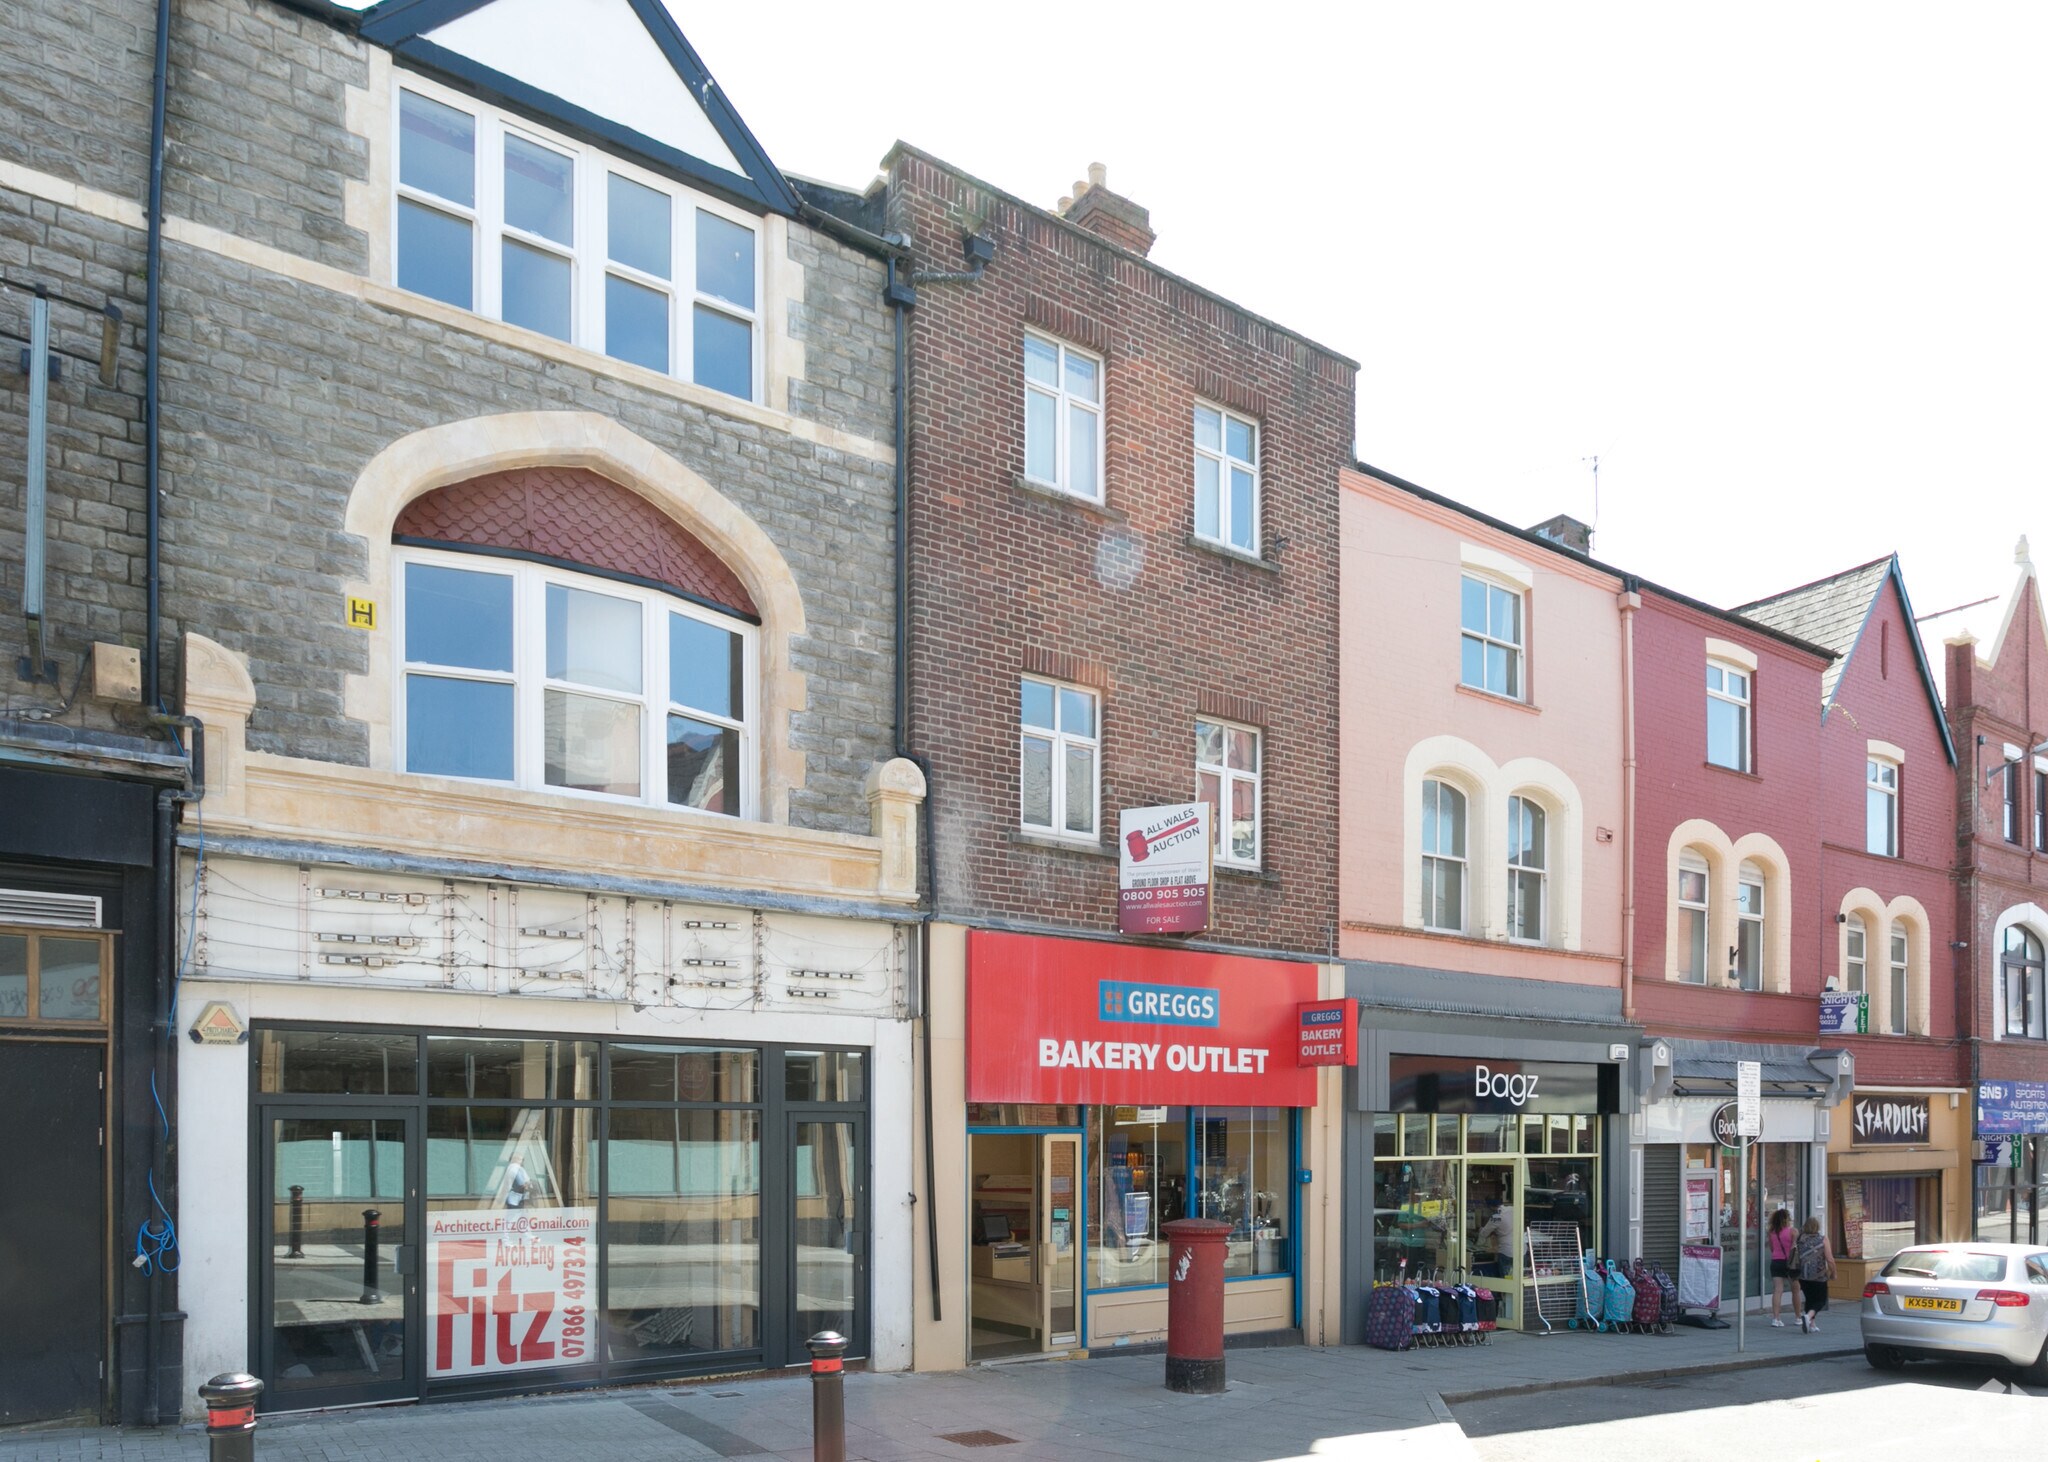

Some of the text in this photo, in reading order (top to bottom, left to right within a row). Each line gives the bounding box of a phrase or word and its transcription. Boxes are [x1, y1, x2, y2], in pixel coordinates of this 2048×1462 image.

[1147, 808, 1195, 836] ALL WALES
[1153, 826, 1201, 854] AUCTION
[1136, 870, 1156, 878] property
[1132, 878, 1147, 888] GROUND
[1148, 877, 1159, 887] FLOOR
[1160, 876, 1170, 886] SHOP
[1174, 876, 1184, 885] FLAT
[1184, 875, 1197, 885] ABOVE
[1122, 887, 1206, 902] 0800 905 905
[1125, 900, 1203, 910] www.allwalesauction.com
[1146, 915, 1180, 924] FOR SALE
[1128, 991, 1214, 1019] GREGGS
[1311, 1011, 1341, 1022] GREGGS
[1301, 1028, 1343, 1041] BAKERY
[1039, 1039, 1269, 1074] BAKERY OUTLET
[1302, 1043, 1343, 1056] OUTLET
[1475, 1065, 1539, 1106] Bagz
[1979, 1086, 2002, 1100] SNS
[2015, 1089, 2046, 1099] SPORTS
[1718, 1119, 1738, 1138] Body
[433, 1216, 590, 1234] Architect.Fitz@Gmail.com
[562, 1236, 587, 1358] 07866 497324
[1908, 1297, 1957, 1310] KX59 WZB
[436, 1239, 556, 1371] Fitz
